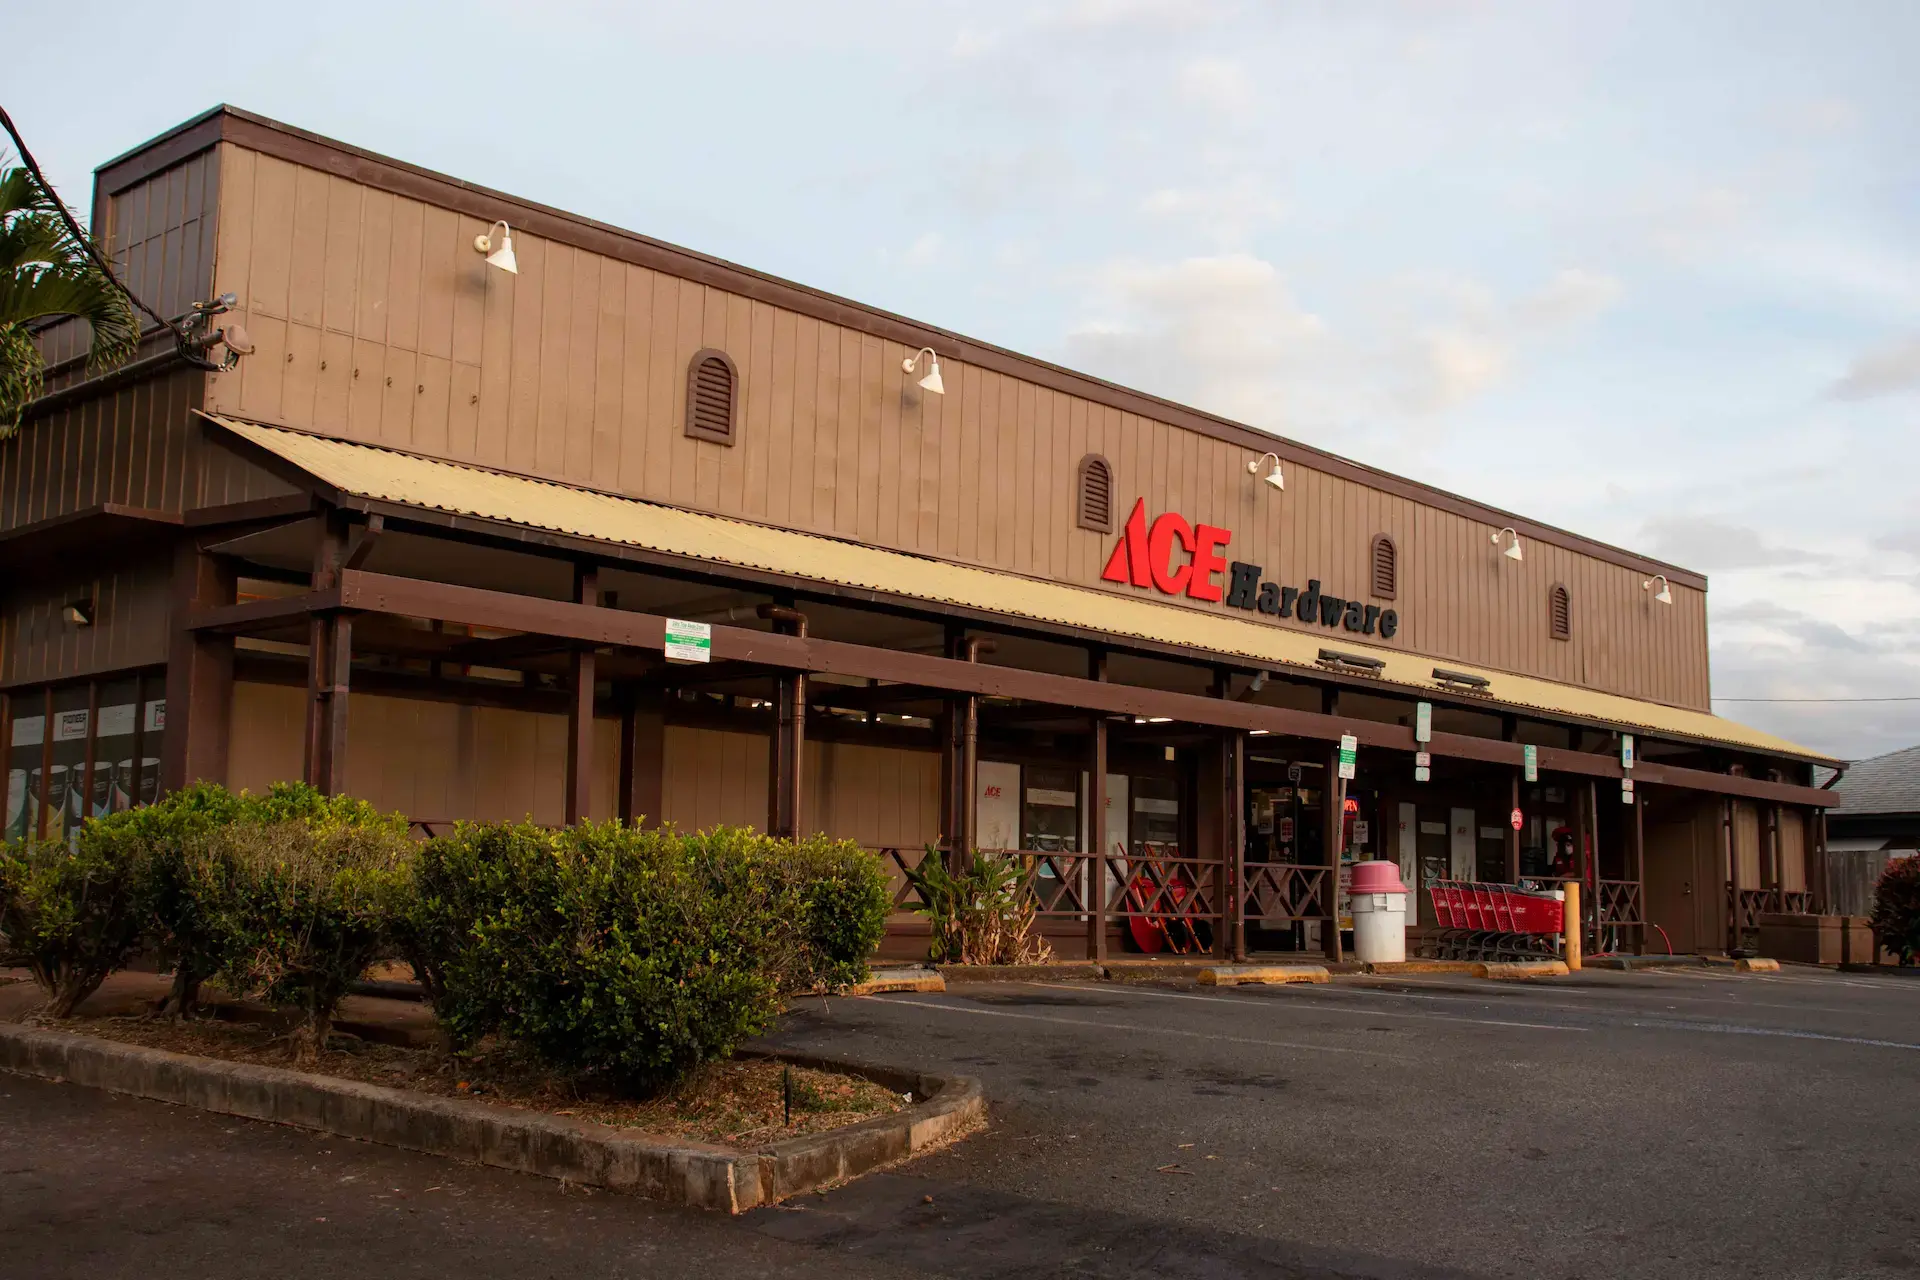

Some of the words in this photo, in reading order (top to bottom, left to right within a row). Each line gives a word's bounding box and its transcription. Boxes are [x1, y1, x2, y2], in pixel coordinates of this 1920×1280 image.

[1101, 496, 1231, 602] ACE
[1227, 561, 1397, 639] Hardware
[63, 713, 86, 724] PIONEER
[984, 785, 1001, 797] ACE
